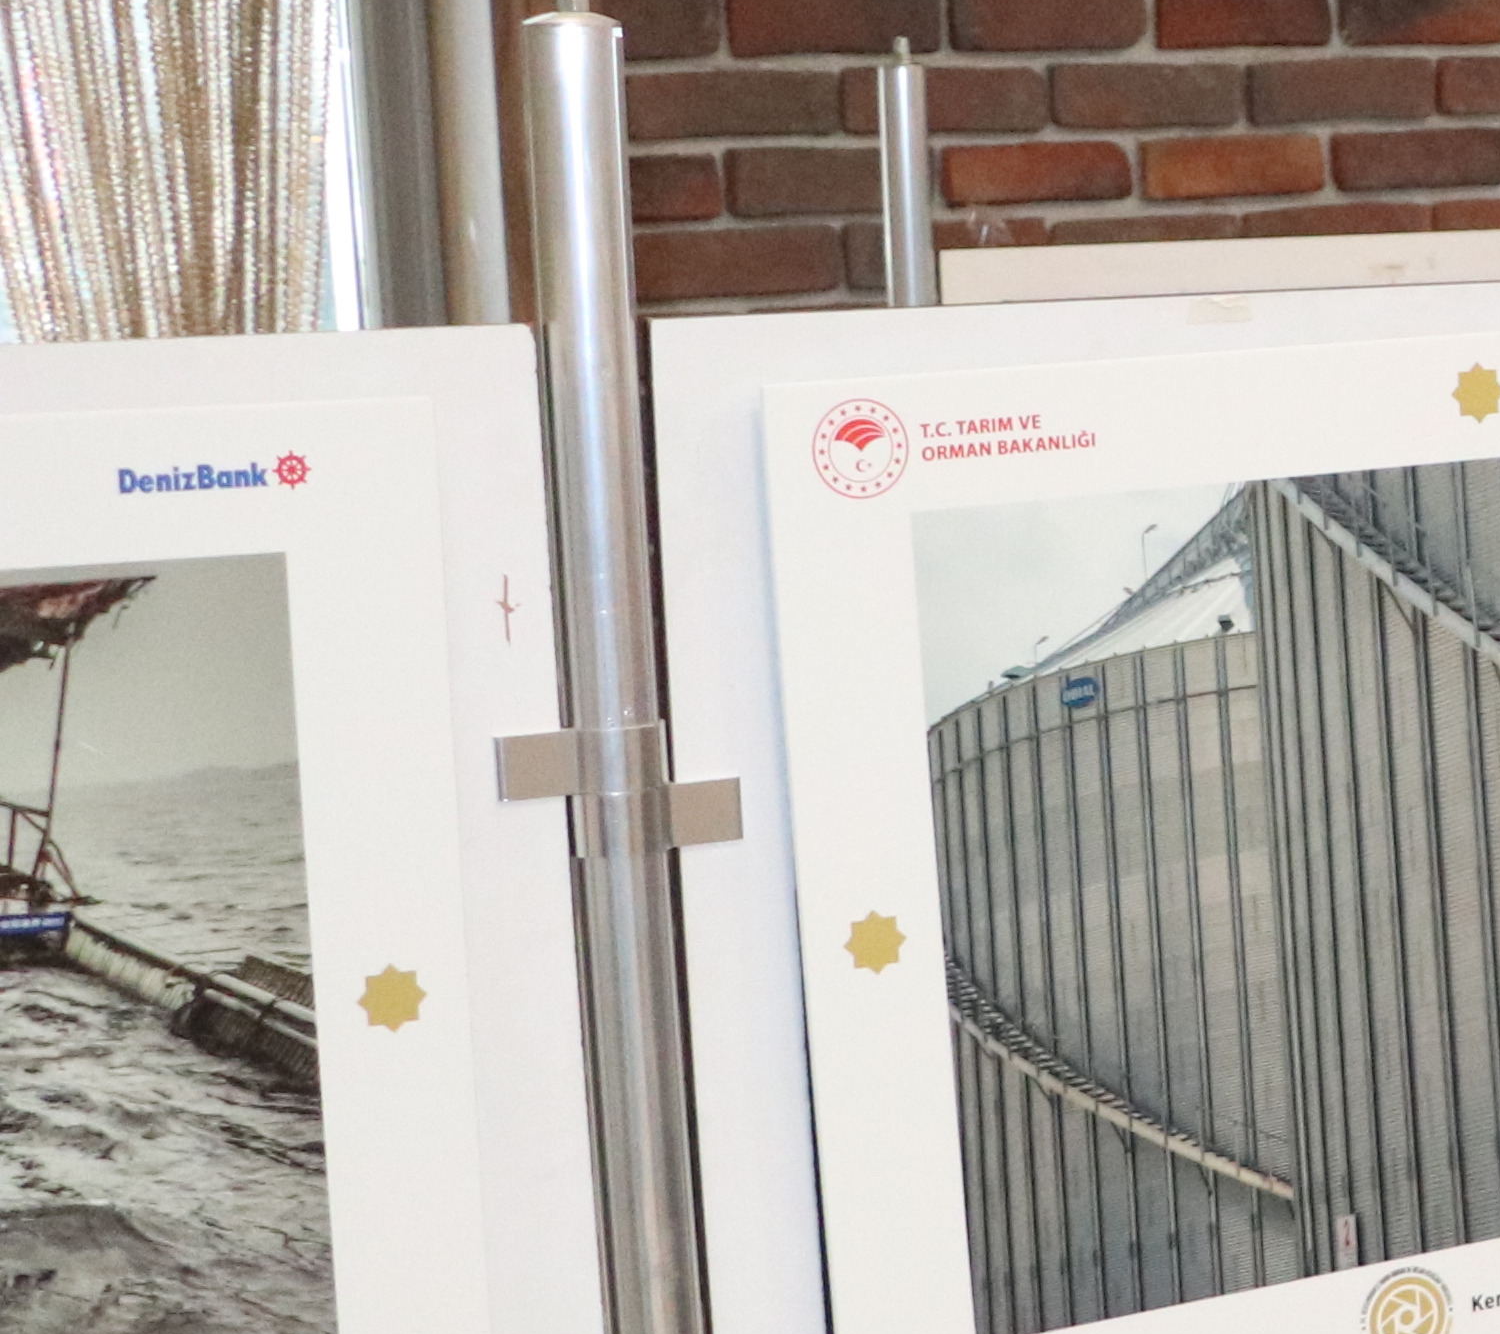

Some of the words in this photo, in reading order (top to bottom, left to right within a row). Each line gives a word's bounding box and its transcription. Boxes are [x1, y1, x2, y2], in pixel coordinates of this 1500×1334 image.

[920, 422, 952, 439] T.C.
[955, 416, 1014, 436] TARIM
[1018, 414, 1042, 430] VE
[921, 440, 992, 462] ORMAN
[997, 429, 1097, 456] BAKANLIĞI
[118, 461, 269, 494] DenizBank
